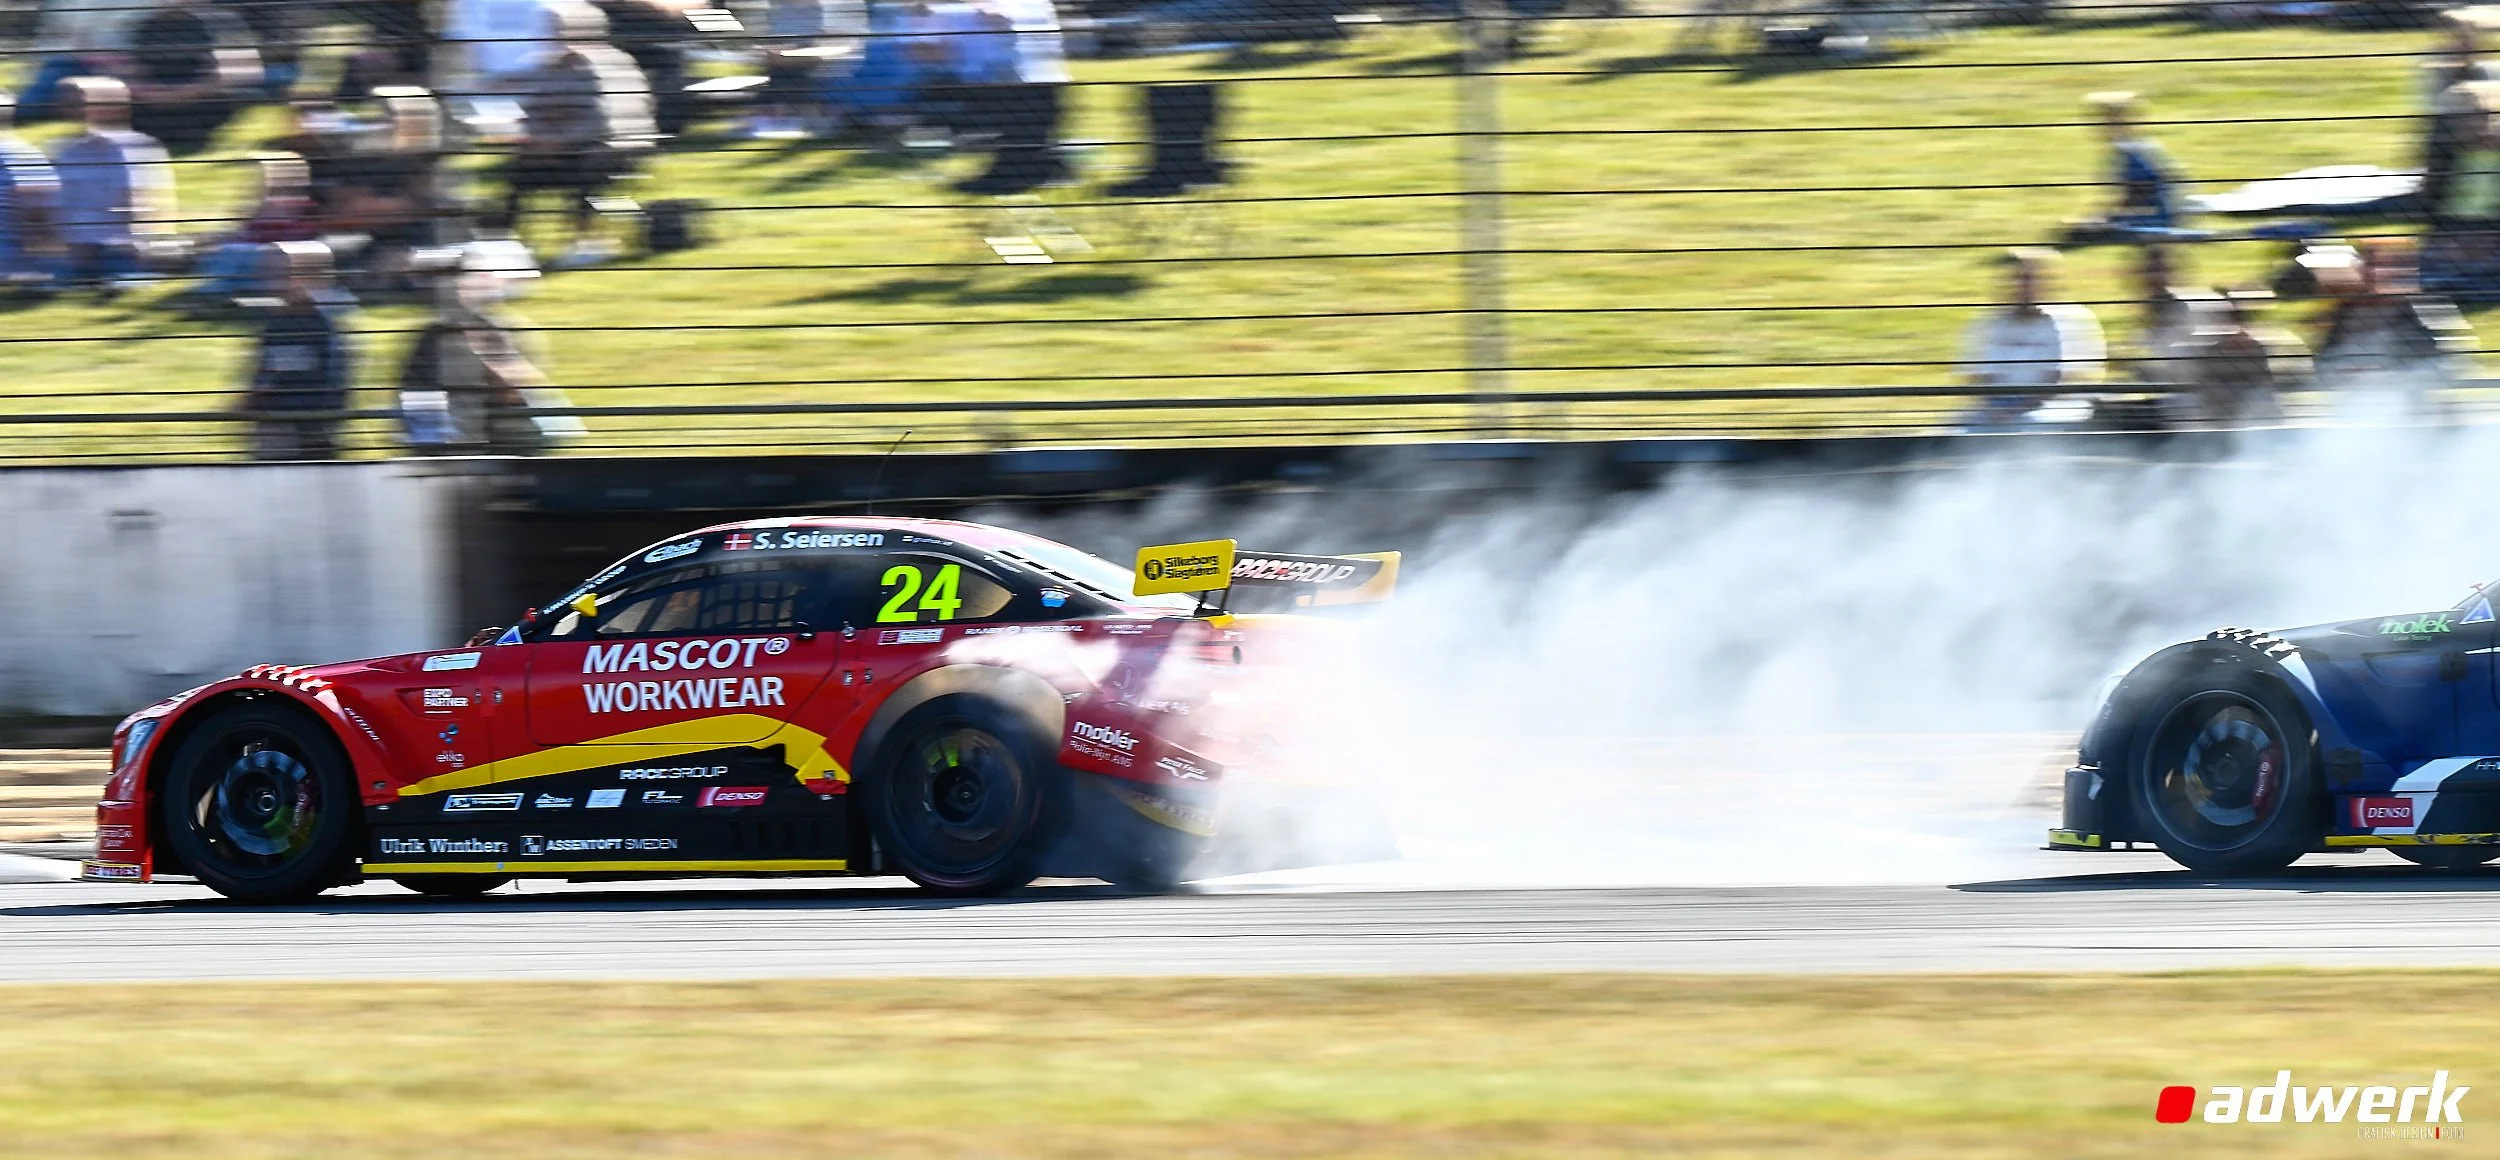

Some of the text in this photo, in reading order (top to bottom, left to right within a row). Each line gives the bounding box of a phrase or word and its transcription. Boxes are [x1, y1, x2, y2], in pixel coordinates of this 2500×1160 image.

[753, 532, 776, 550] S.
[780, 531, 884, 549] Seiersen
[875, 563, 963, 623] 24
[2379, 615, 2454, 634] nolek
[582, 676, 786, 714] WORKWEAR
[619, 766, 729, 780] RACEGROUP
[714, 791, 765, 802] DENSO
[2367, 807, 2411, 818] DENSO
[380, 838, 426, 853] Ulrik
[546, 838, 623, 851] ASSENTOFT
[624, 838, 679, 850] SWEDEN
